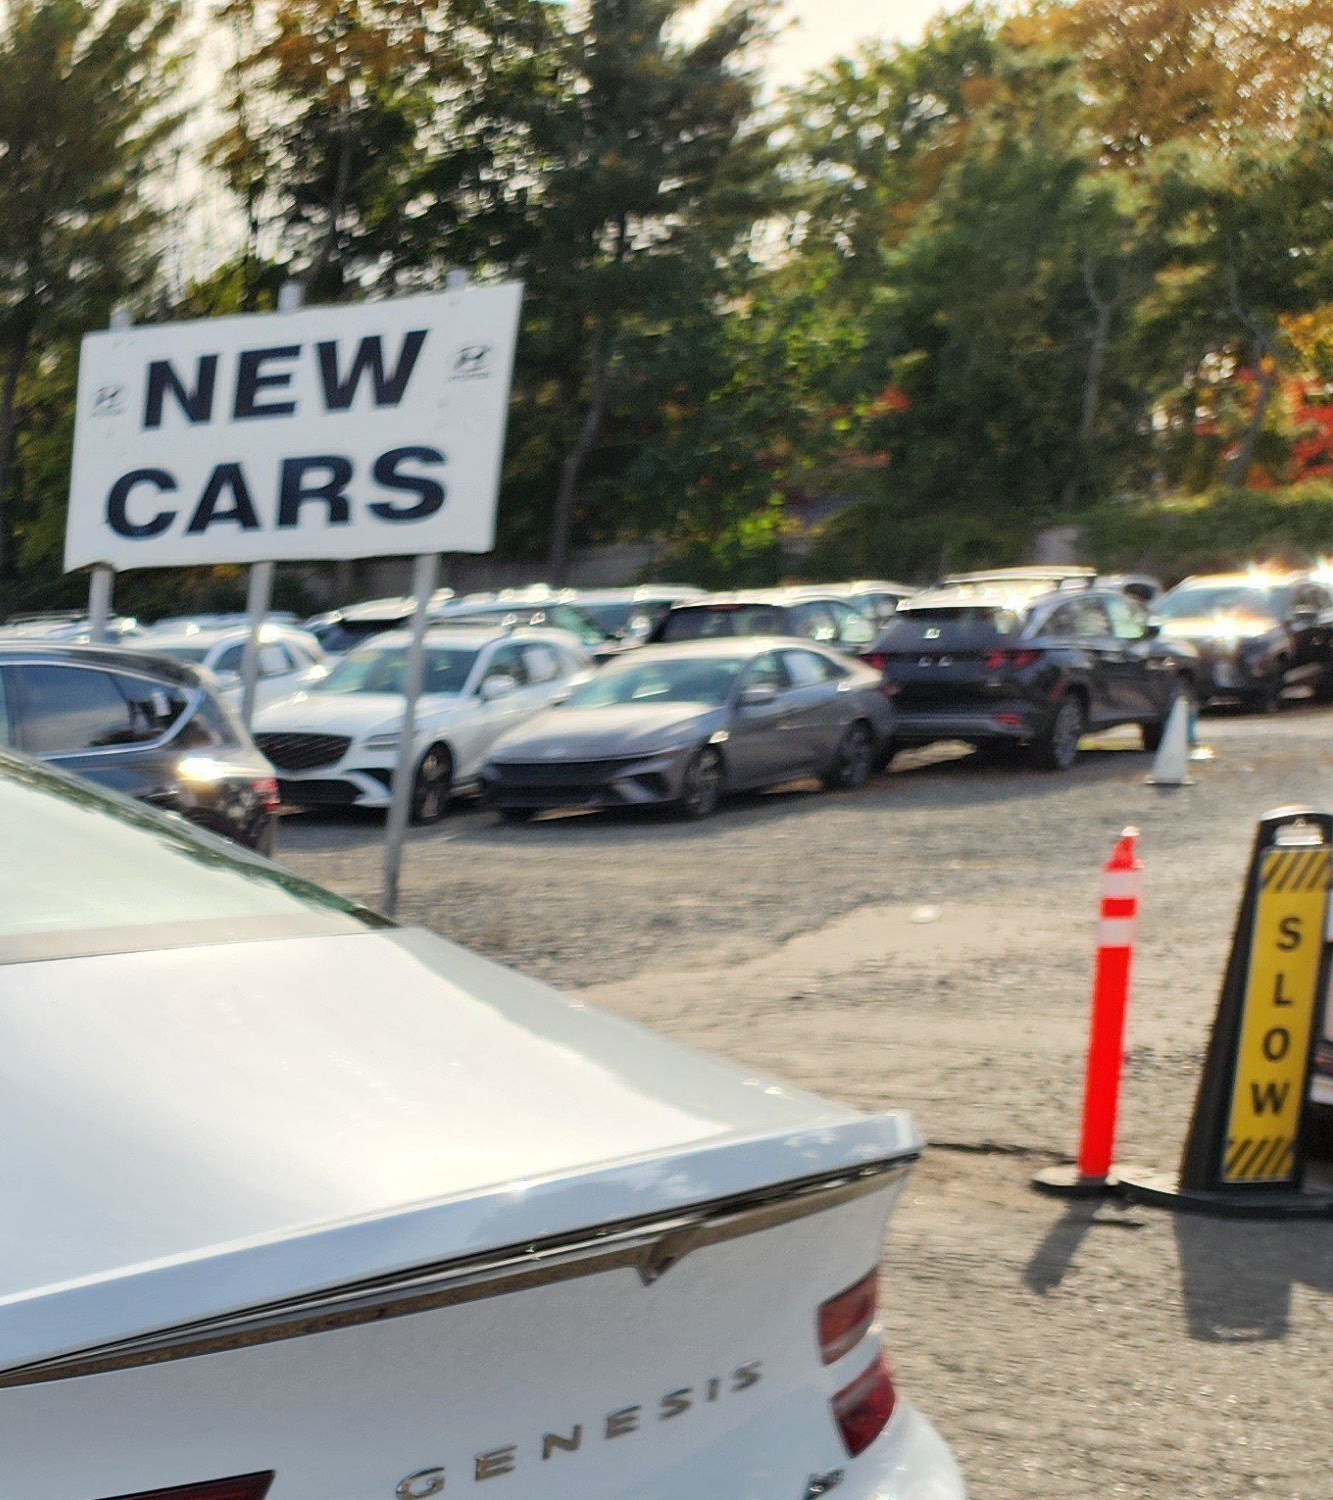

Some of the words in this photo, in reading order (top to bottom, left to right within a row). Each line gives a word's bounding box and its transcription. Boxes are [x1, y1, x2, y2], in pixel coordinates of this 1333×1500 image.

[143, 329, 428, 430] NEW
[106, 446, 447, 541] CARS
[1250, 916, 1302, 1116] SLOW
